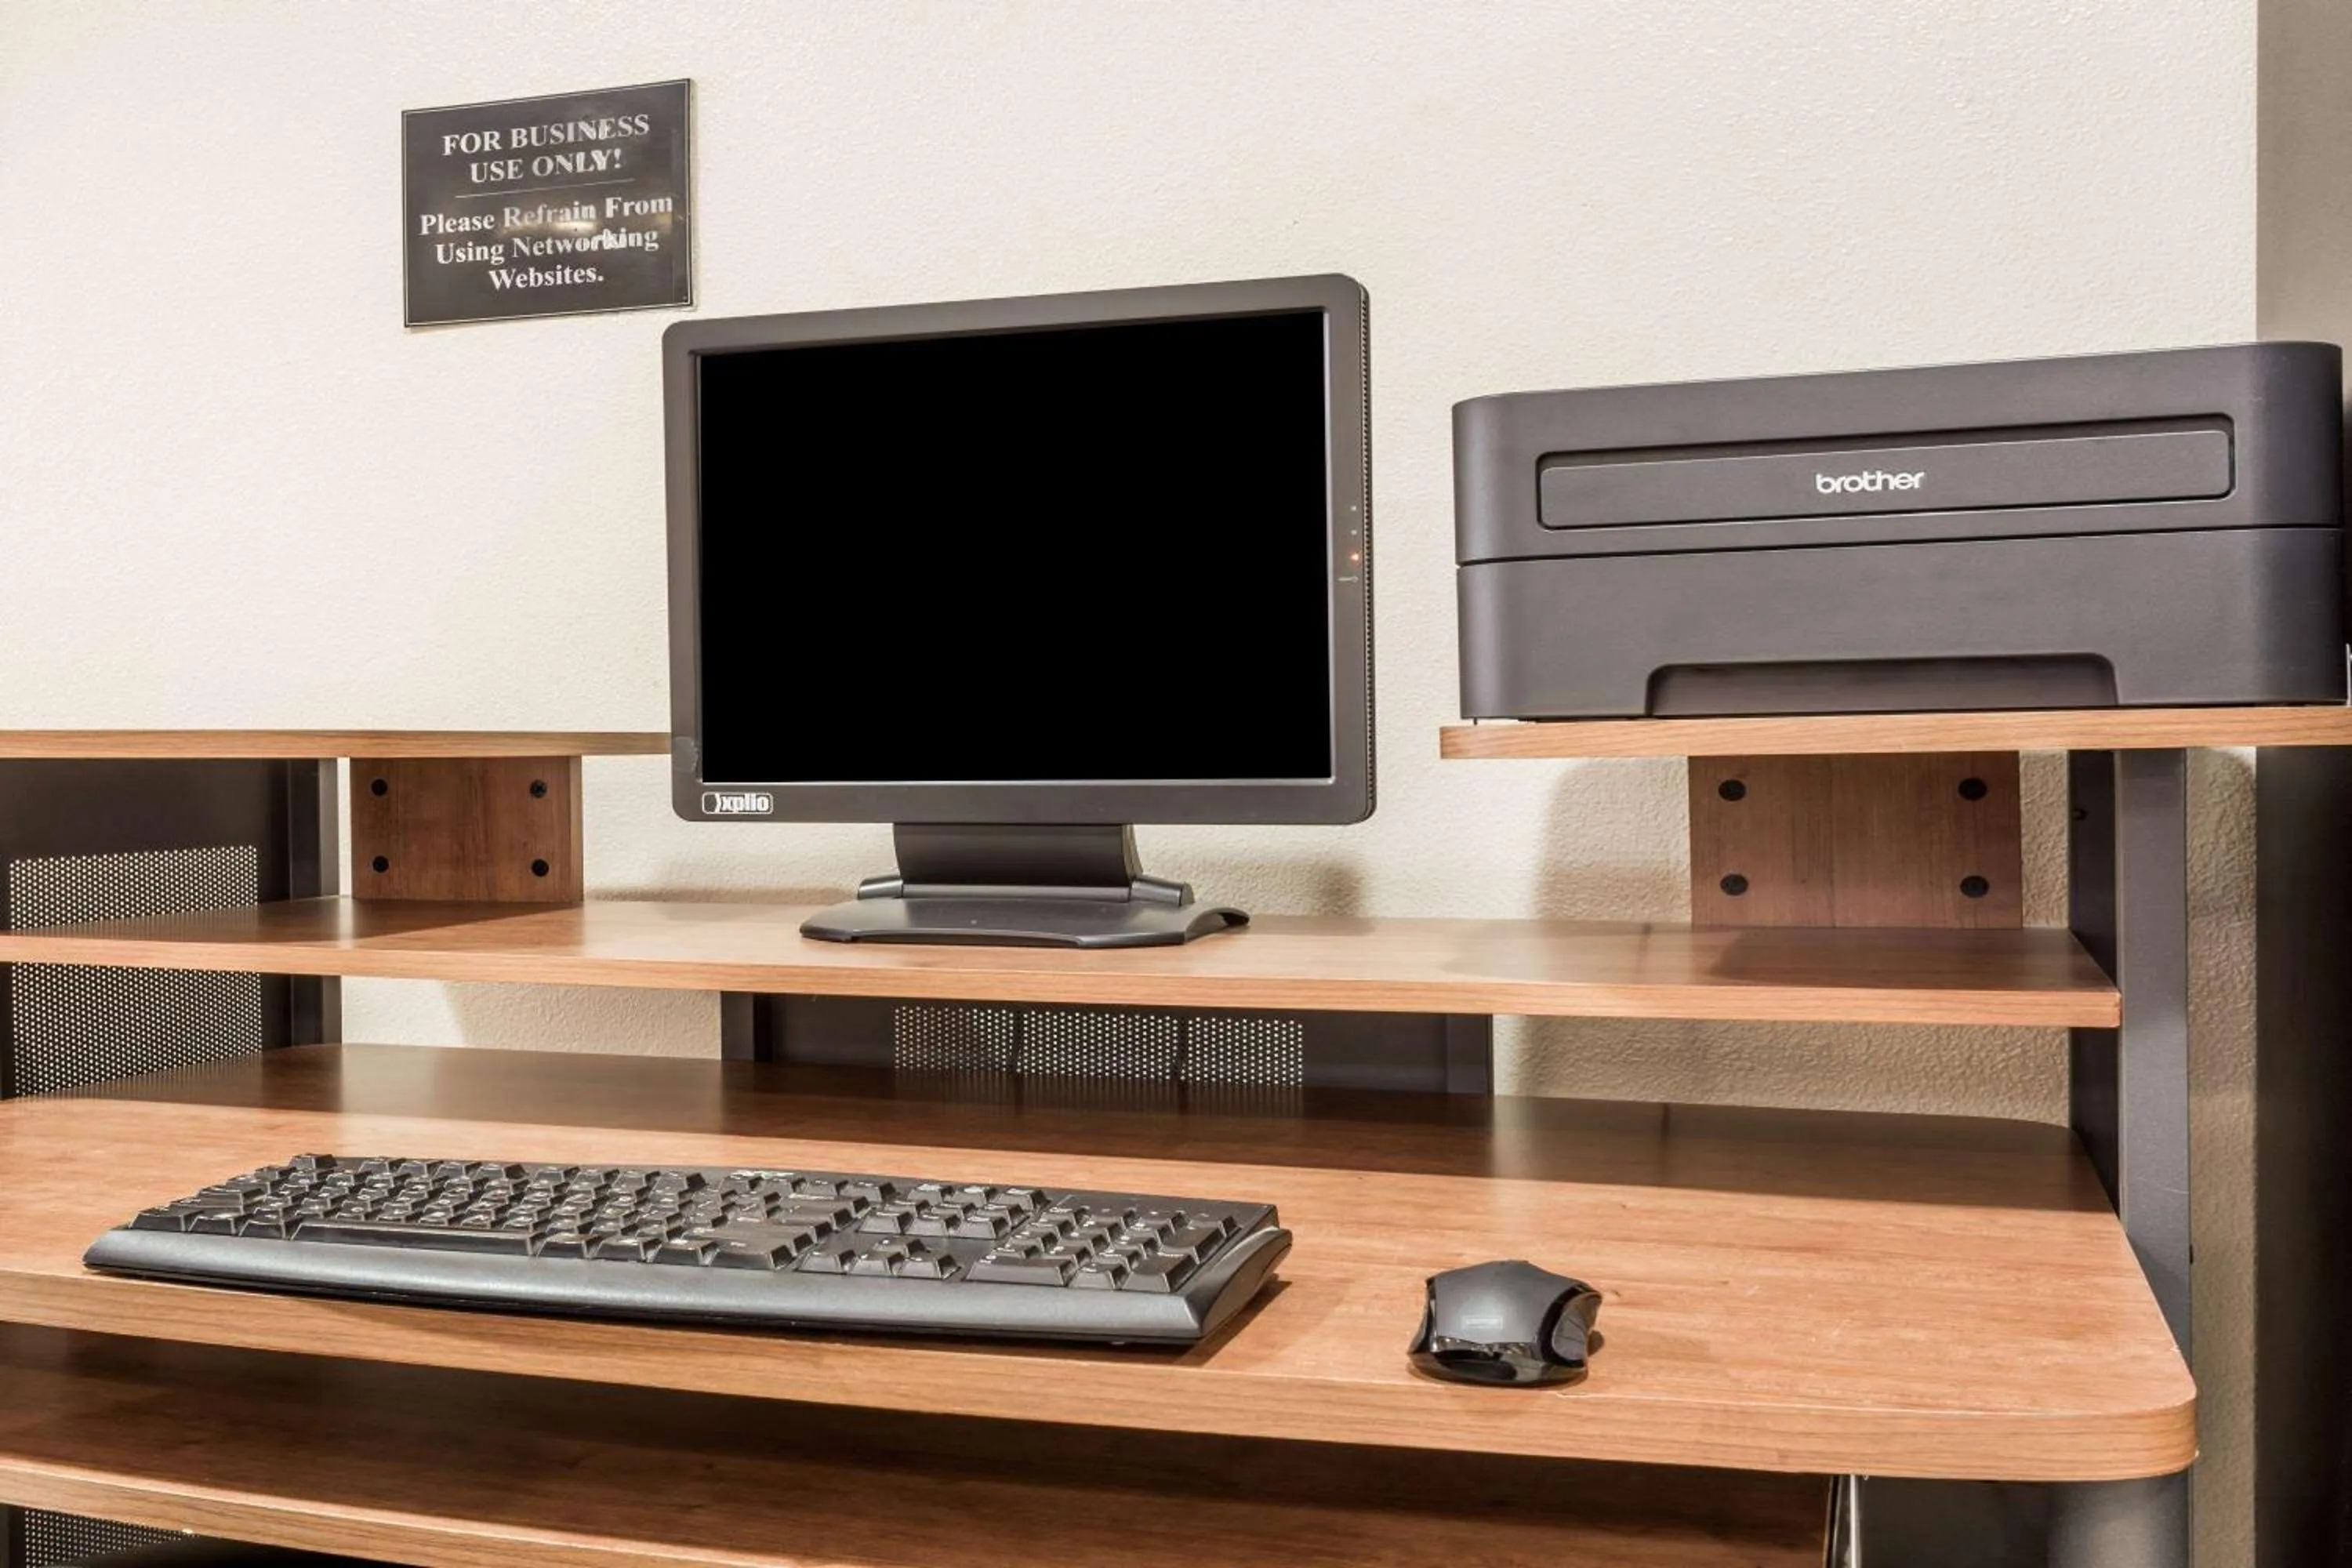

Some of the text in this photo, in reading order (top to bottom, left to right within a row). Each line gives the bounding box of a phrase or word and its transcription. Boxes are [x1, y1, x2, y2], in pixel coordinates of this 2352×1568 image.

[442, 114, 650, 156] FOR BUSINESS
[470, 148, 622, 183] USE ONLY!
[419, 196, 672, 235] Please Refrain From
[435, 228, 659, 265] Using Networking
[488, 264, 604, 291] Websites.
[1816, 470, 1924, 493] brother
